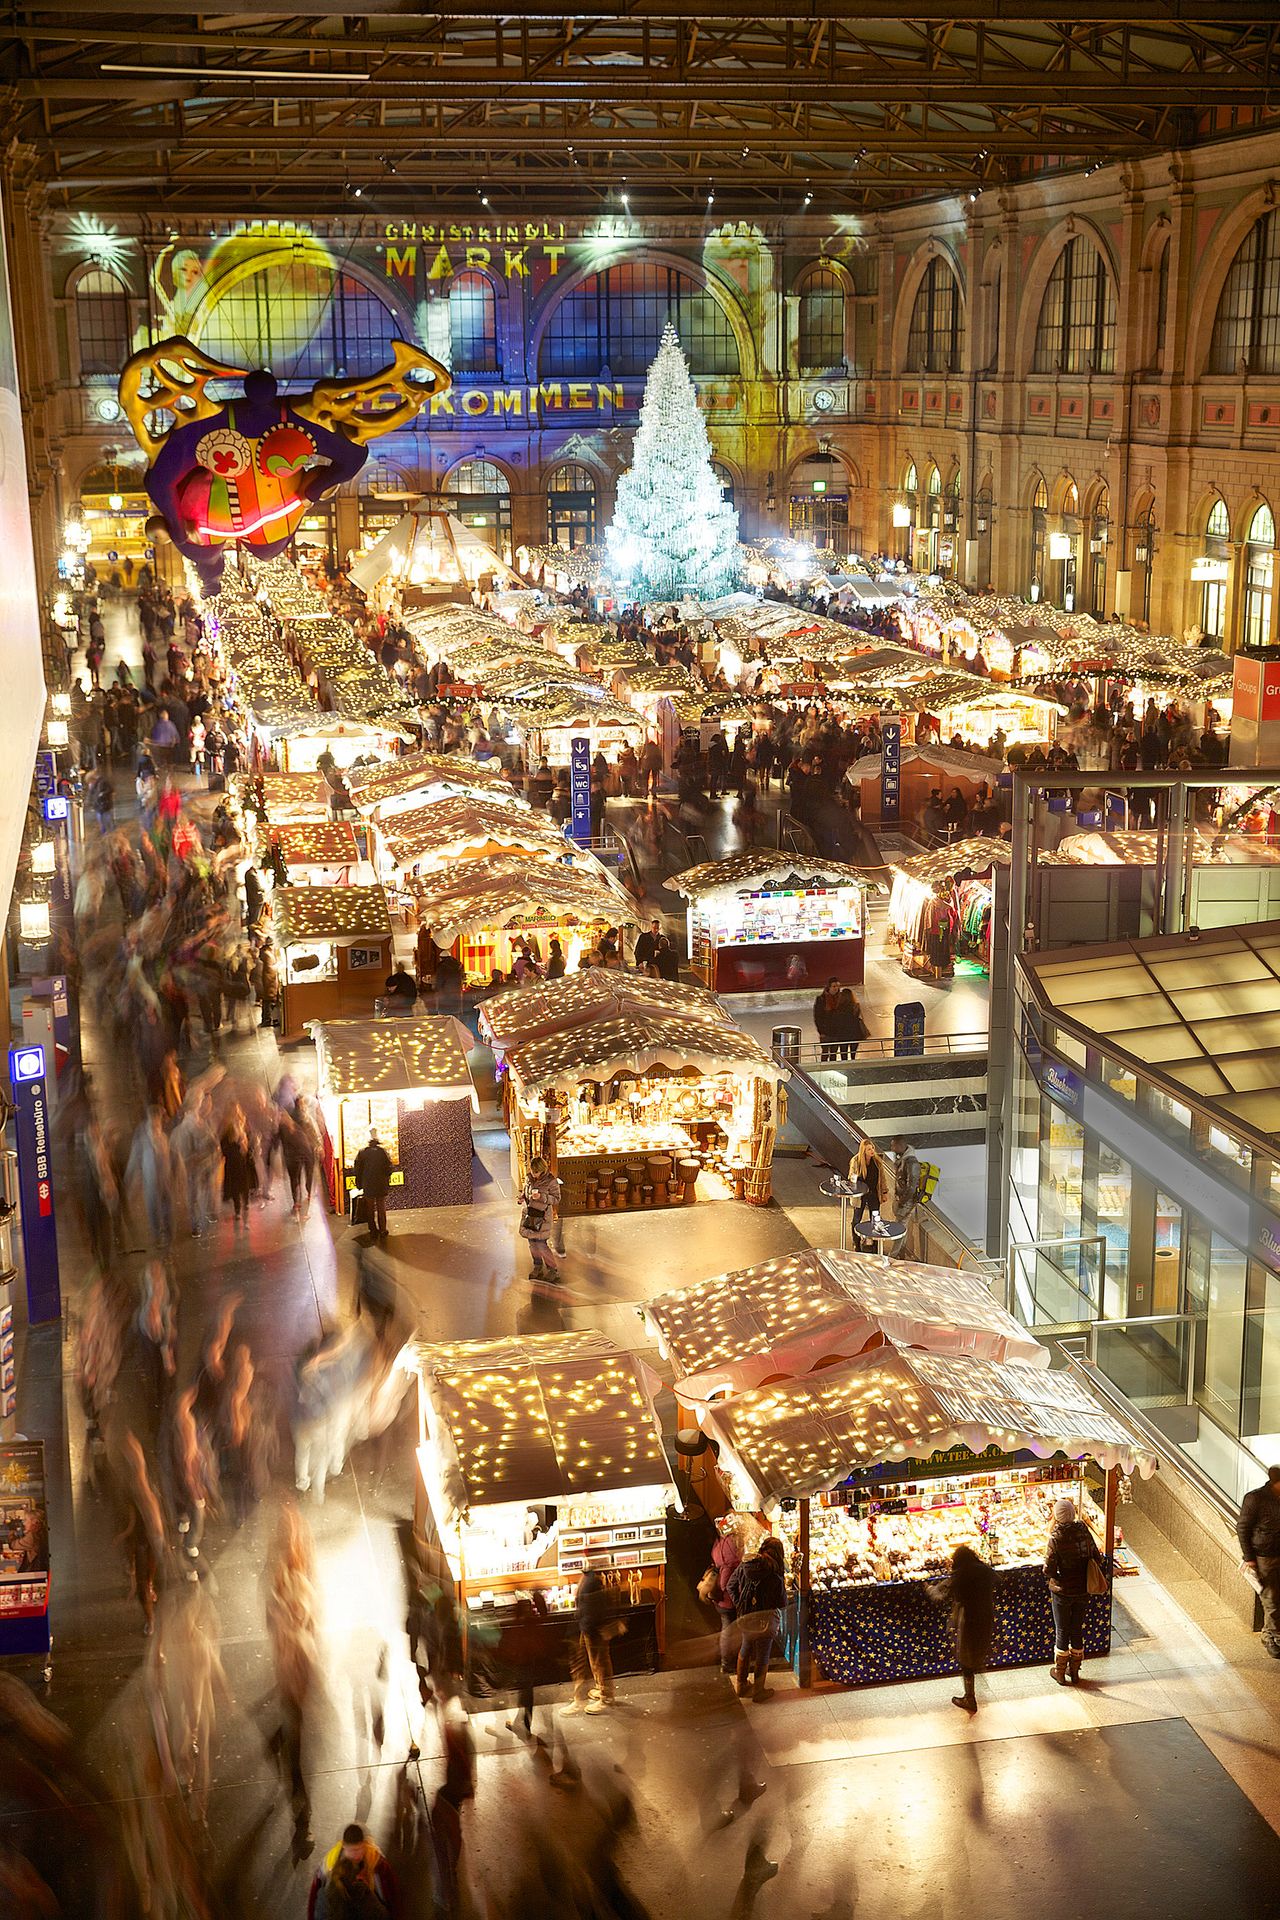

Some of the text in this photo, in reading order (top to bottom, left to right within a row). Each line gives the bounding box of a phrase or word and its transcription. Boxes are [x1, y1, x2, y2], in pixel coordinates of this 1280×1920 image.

[386, 245, 567, 280] MARKT
[1237, 680, 1257, 695] Groups
[34, 1099, 48, 1179] SBB Reisebüro
